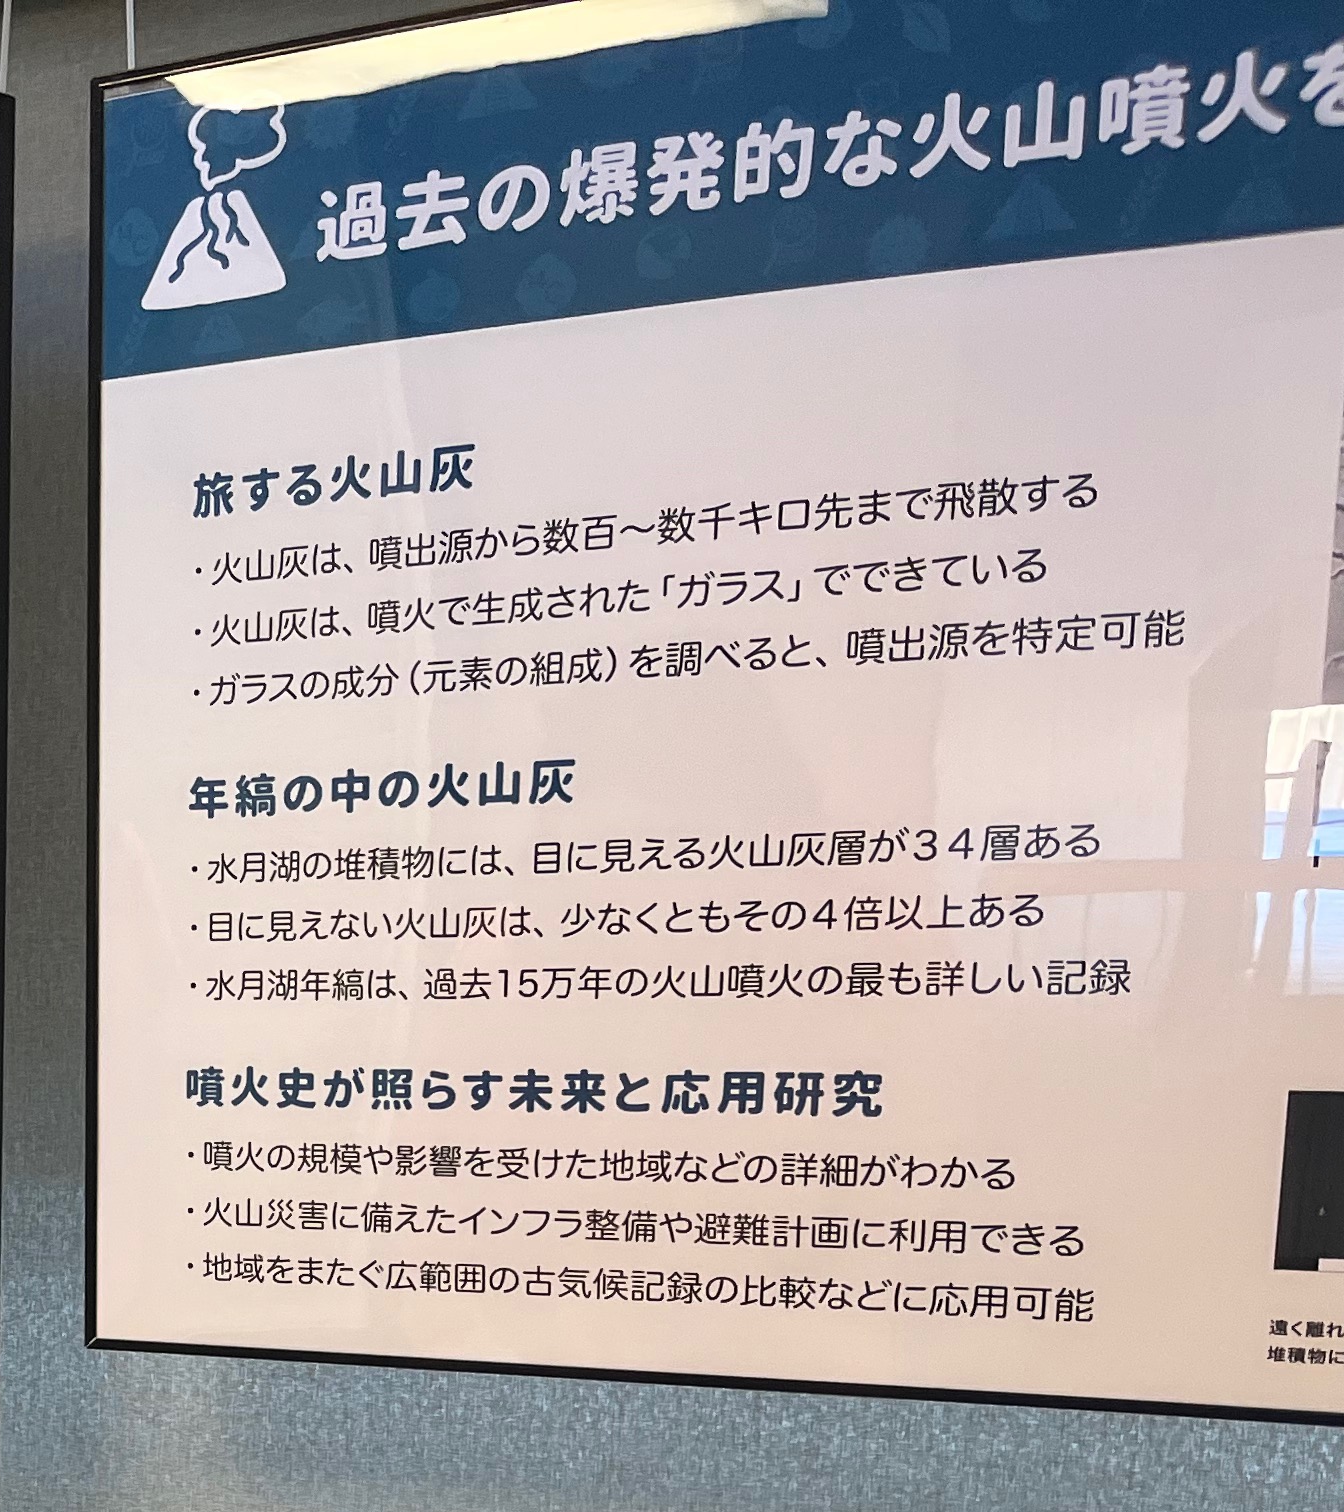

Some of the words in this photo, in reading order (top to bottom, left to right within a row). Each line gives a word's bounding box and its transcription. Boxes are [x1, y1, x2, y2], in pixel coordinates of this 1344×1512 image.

[193, 444, 475, 518] 旅する火山灰
[188, 759, 576, 819] 年縞の中の火山灰
[185, 1066, 883, 1117] 噴火史が照らす未来と応用研究
